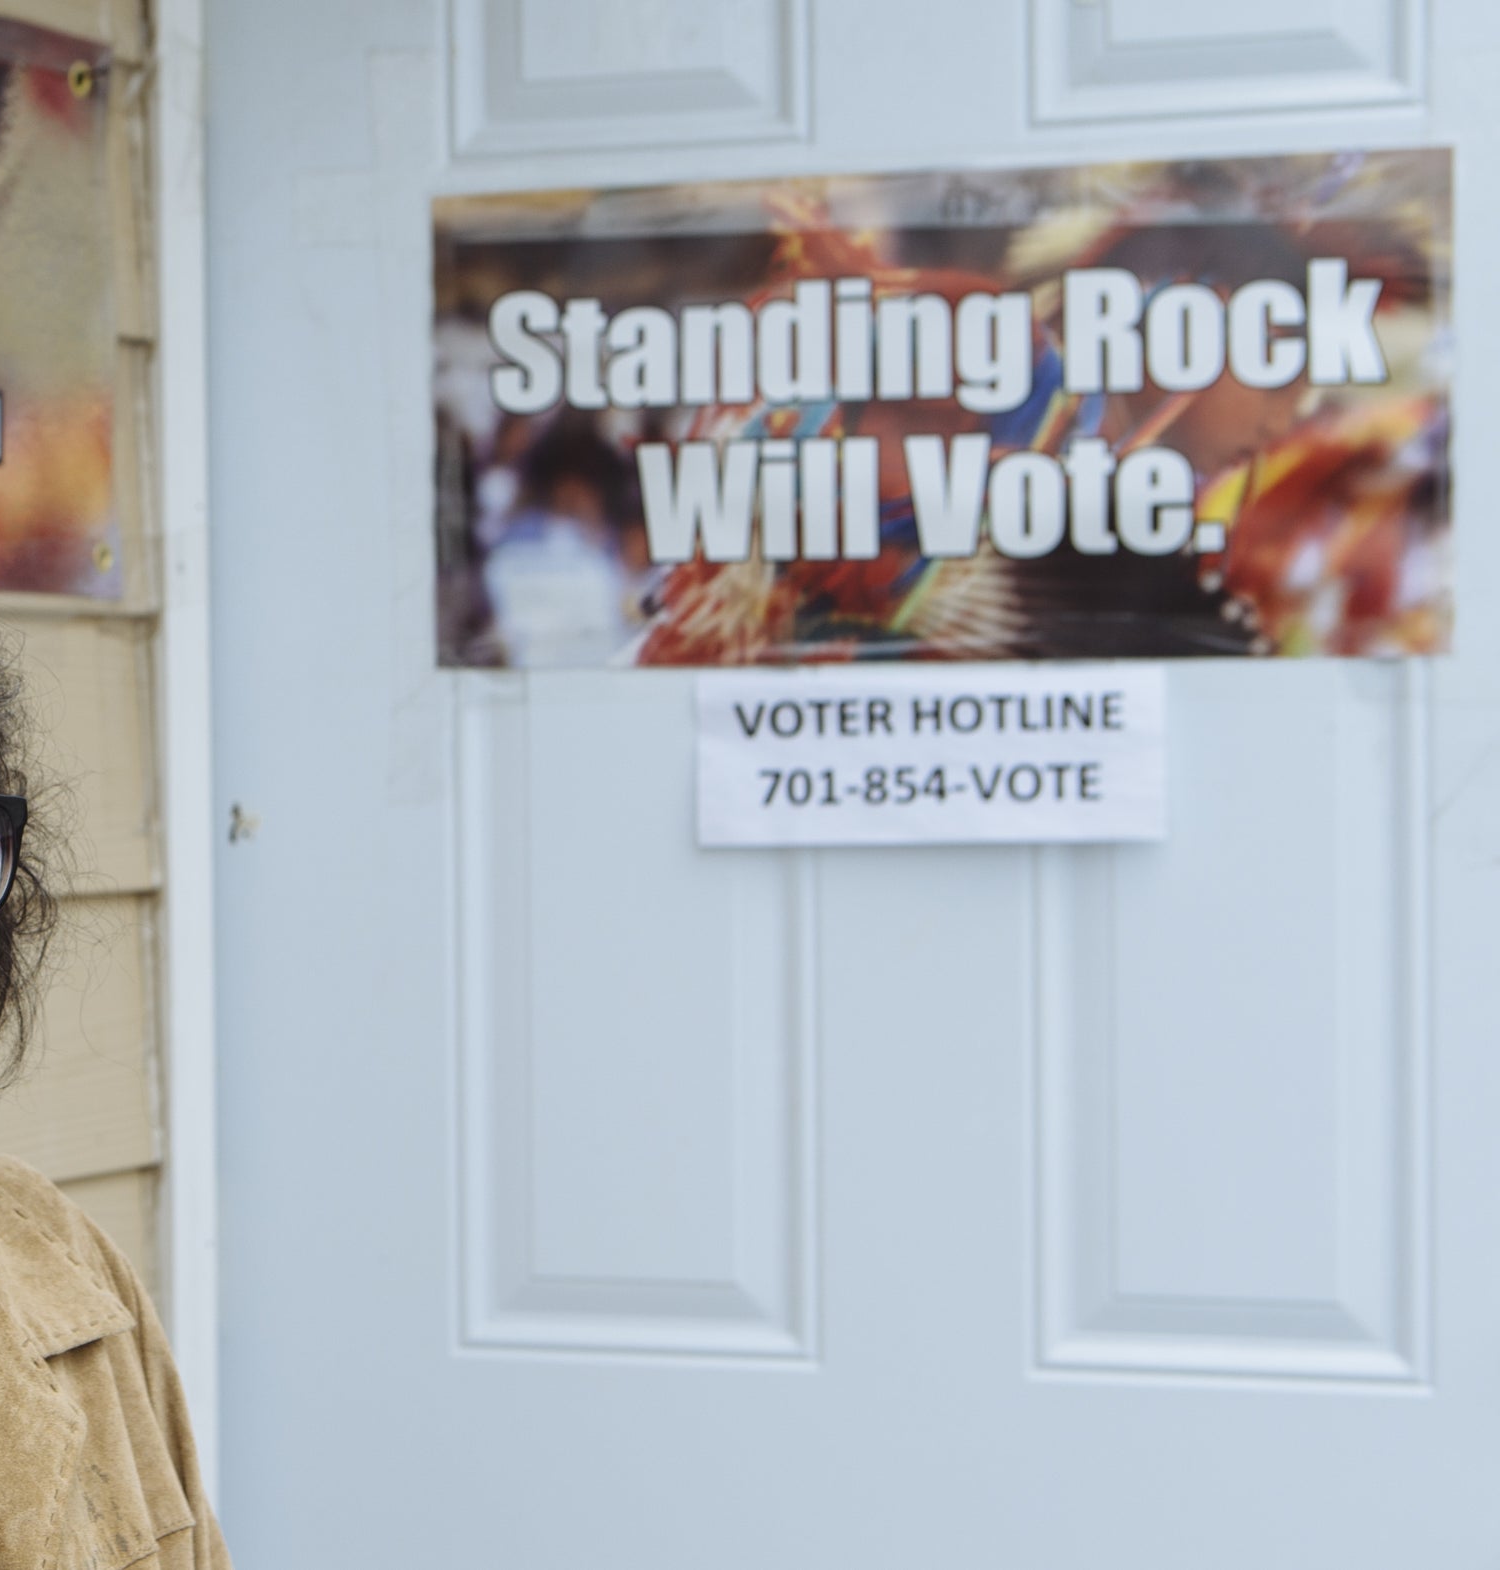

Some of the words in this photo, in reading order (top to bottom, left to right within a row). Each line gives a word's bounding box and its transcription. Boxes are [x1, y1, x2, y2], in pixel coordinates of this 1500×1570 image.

[488, 277, 1031, 413] Standing
[1062, 258, 1388, 394] Rock
[636, 437, 880, 564] Will
[903, 433, 1226, 559] Vote.
[733, 695, 896, 740] VOTER
[911, 690, 1127, 735] HOTLINE
[758, 762, 1104, 808] 701-854-VOTE
